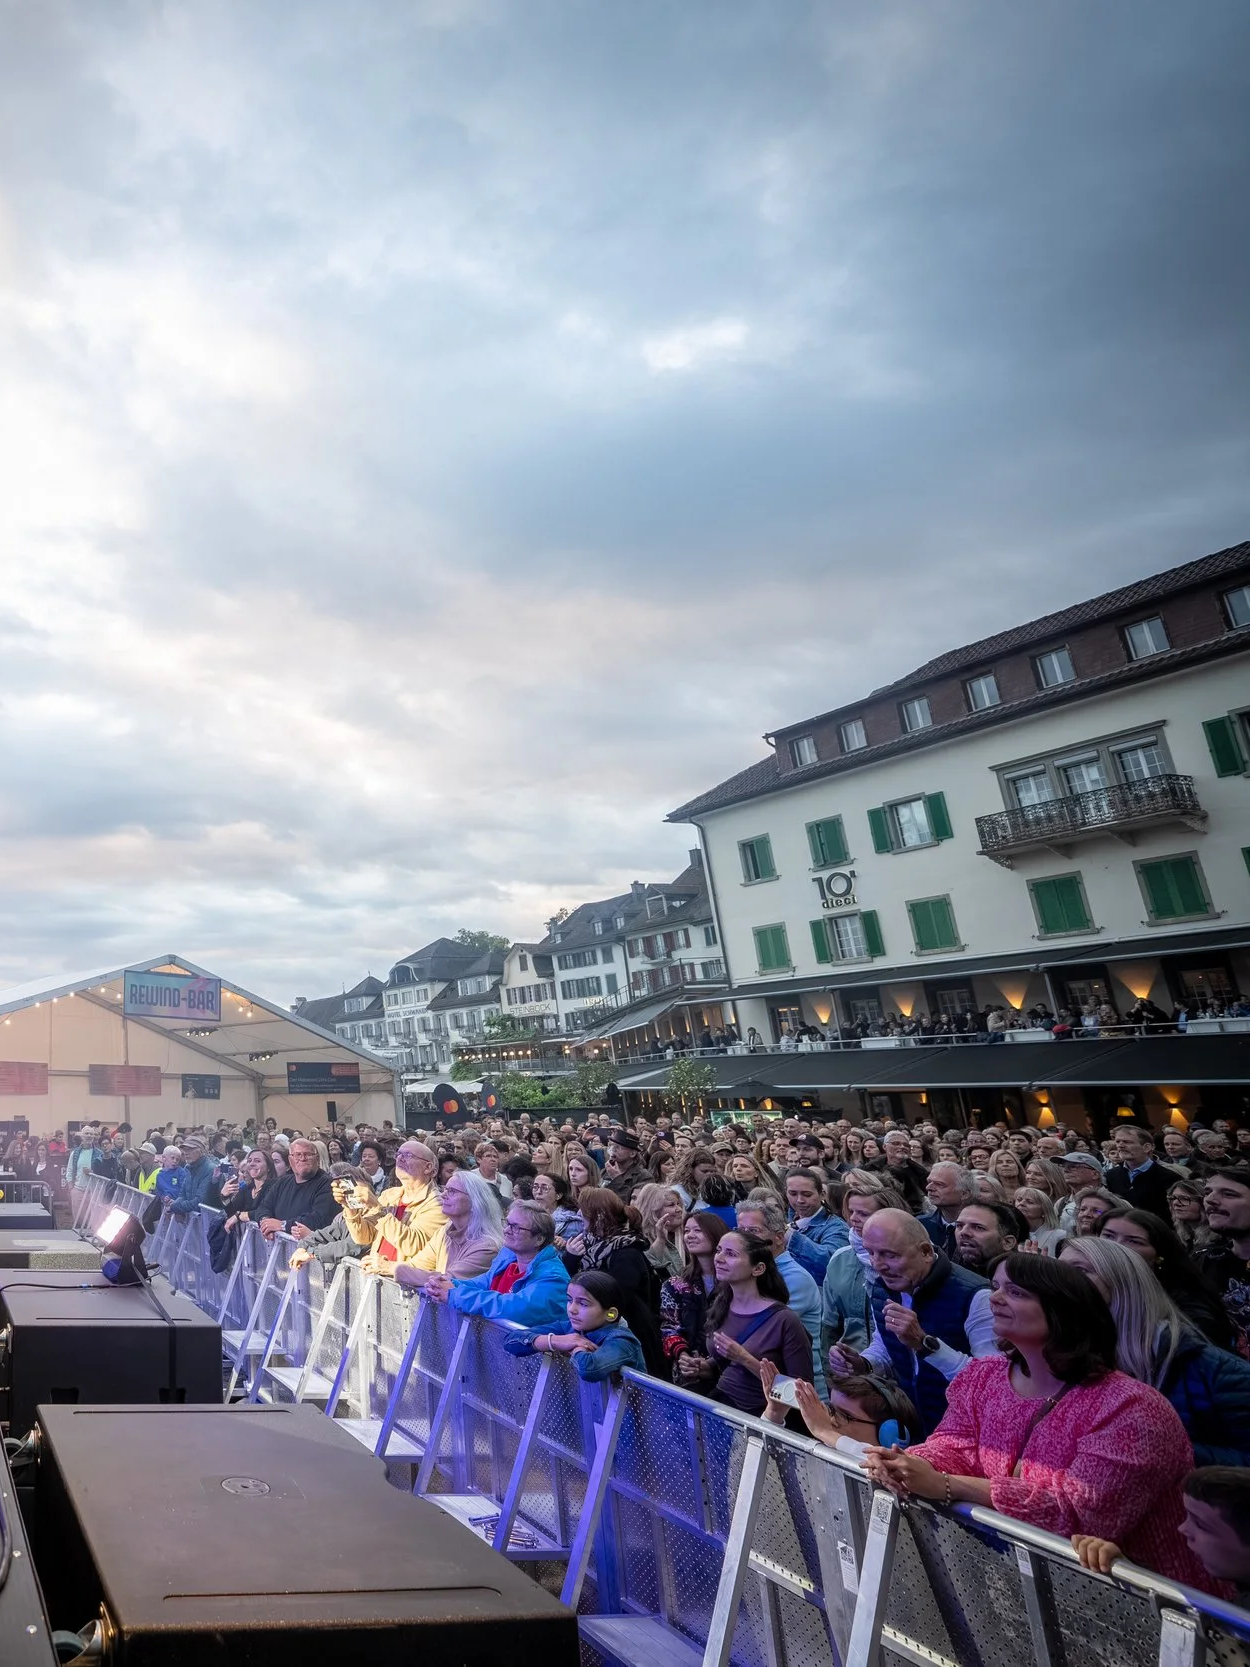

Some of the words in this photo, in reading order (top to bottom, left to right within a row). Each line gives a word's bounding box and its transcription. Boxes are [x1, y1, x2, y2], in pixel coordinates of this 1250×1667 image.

[822, 894, 857, 909] dieci
[129, 983, 215, 1011] REWIND-BAR
[387, 1010, 401, 1019] HOTEL
[509, 1003, 551, 1015] STEINBOCK
